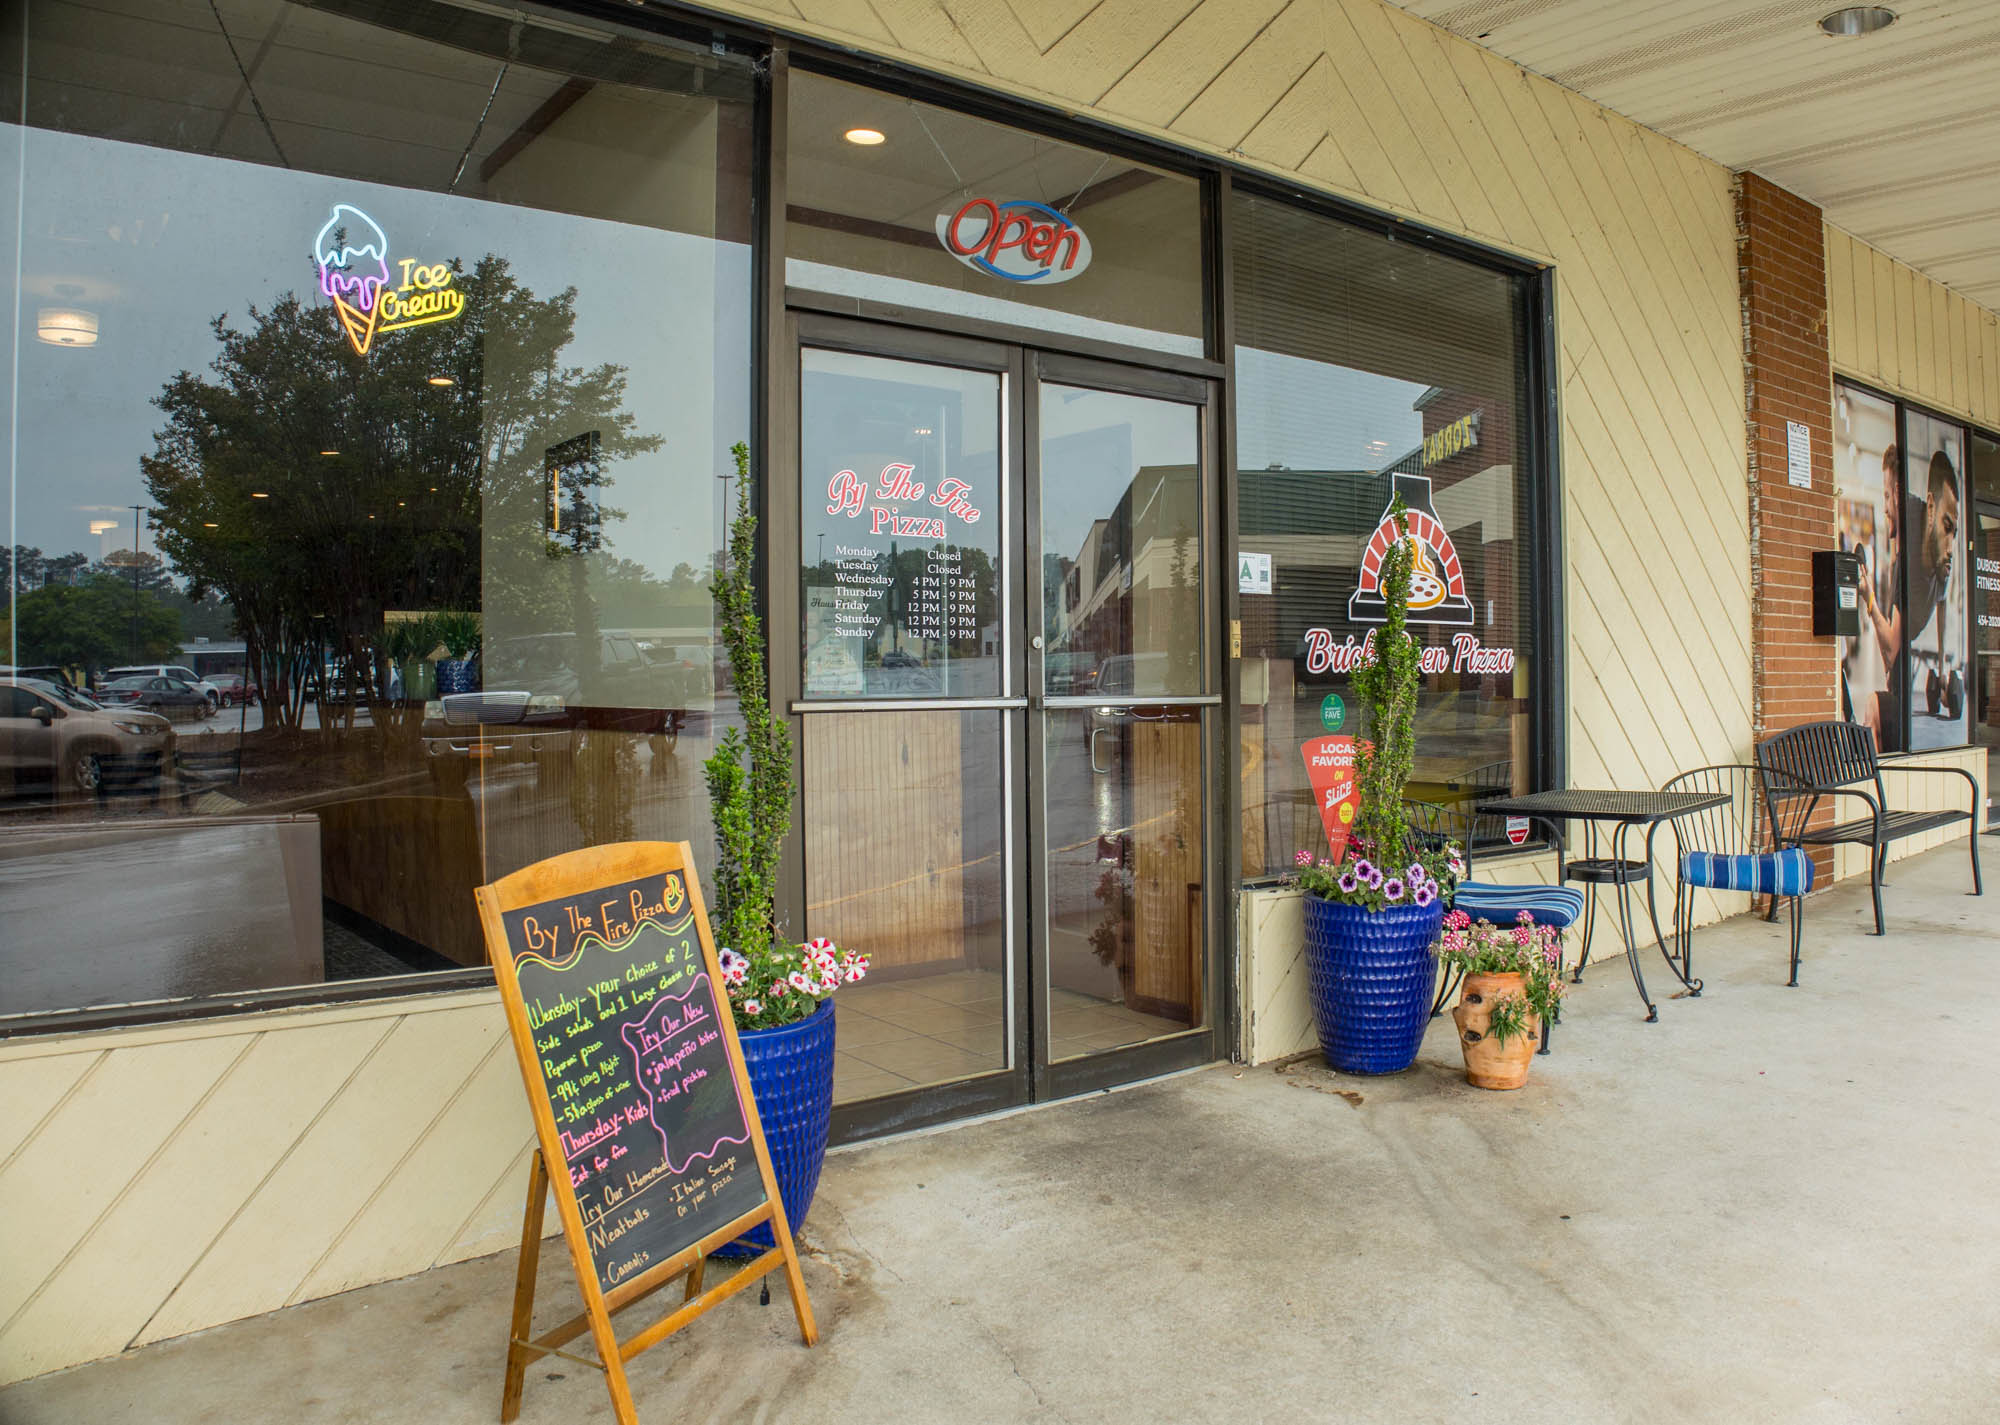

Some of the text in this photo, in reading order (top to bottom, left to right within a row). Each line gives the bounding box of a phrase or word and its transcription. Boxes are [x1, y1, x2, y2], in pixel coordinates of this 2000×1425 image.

[950, 197, 1081, 270] Open
[398, 258, 452, 292] Ice
[379, 289, 466, 321] Cream
[826, 462, 981, 523] By The Fire
[870, 506, 947, 539] Pizza
[835, 545, 961, 561] Monday Closed
[1976, 557, 2000, 574] DUBOSE
[834, 572, 894, 587] Wednesday
[912, 577, 920, 587] 4
[922, 577, 940, 587] PM
[949, 578, 956, 588] 9
[958, 579, 976, 589] PM
[835, 560, 961, 575] Tuesday Closed
[1240, 559, 1253, 580] A
[834, 586, 884, 600] Thursday
[912, 590, 920, 600] 5
[922, 590, 940, 600] PM
[949, 591, 956, 600] 9
[958, 591, 976, 601] PM
[1976, 575, 2000, 591] FITNESS
[834, 599, 869, 613] Friday
[908, 602, 920, 612] 12
[922, 603, 940, 613] PM
[949, 604, 956, 613] 9
[958, 604, 976, 614] PM
[834, 613, 881, 626] Saturday
[908, 616, 920, 626] 12
[922, 616, 940, 626] PM
[949, 617, 956, 626] 9
[958, 617, 976, 627] PM
[834, 627, 874, 639] Sunday
[908, 629, 920, 638] 12
[922, 629, 940, 639] PM
[949, 629, 956, 639] 9
[958, 630, 976, 640] PM
[1452, 632, 1515, 674] Pizza
[1325, 710, 1342, 720] FAVE
[523, 889, 665, 958] By The Fire Pizza
[665, 947, 676, 964] of
[681, 940, 694, 960] 2
[537, 1034, 561, 1054] Side
[600, 1001, 617, 1020] and
[617, 995, 629, 1011] 1
[635, 1001, 704, 1053] Try Our New
[698, 1030, 719, 1046] bites
[661, 1080, 681, 1103] fried
[624, 1099, 649, 1127] Kids
[568, 1144, 629, 1189] Eat for free
[576, 1193, 606, 1225] Try
[604, 1185, 624, 1207] Our
[591, 1207, 650, 1256] Meatballs
[607, 1250, 650, 1285] Cannolis
